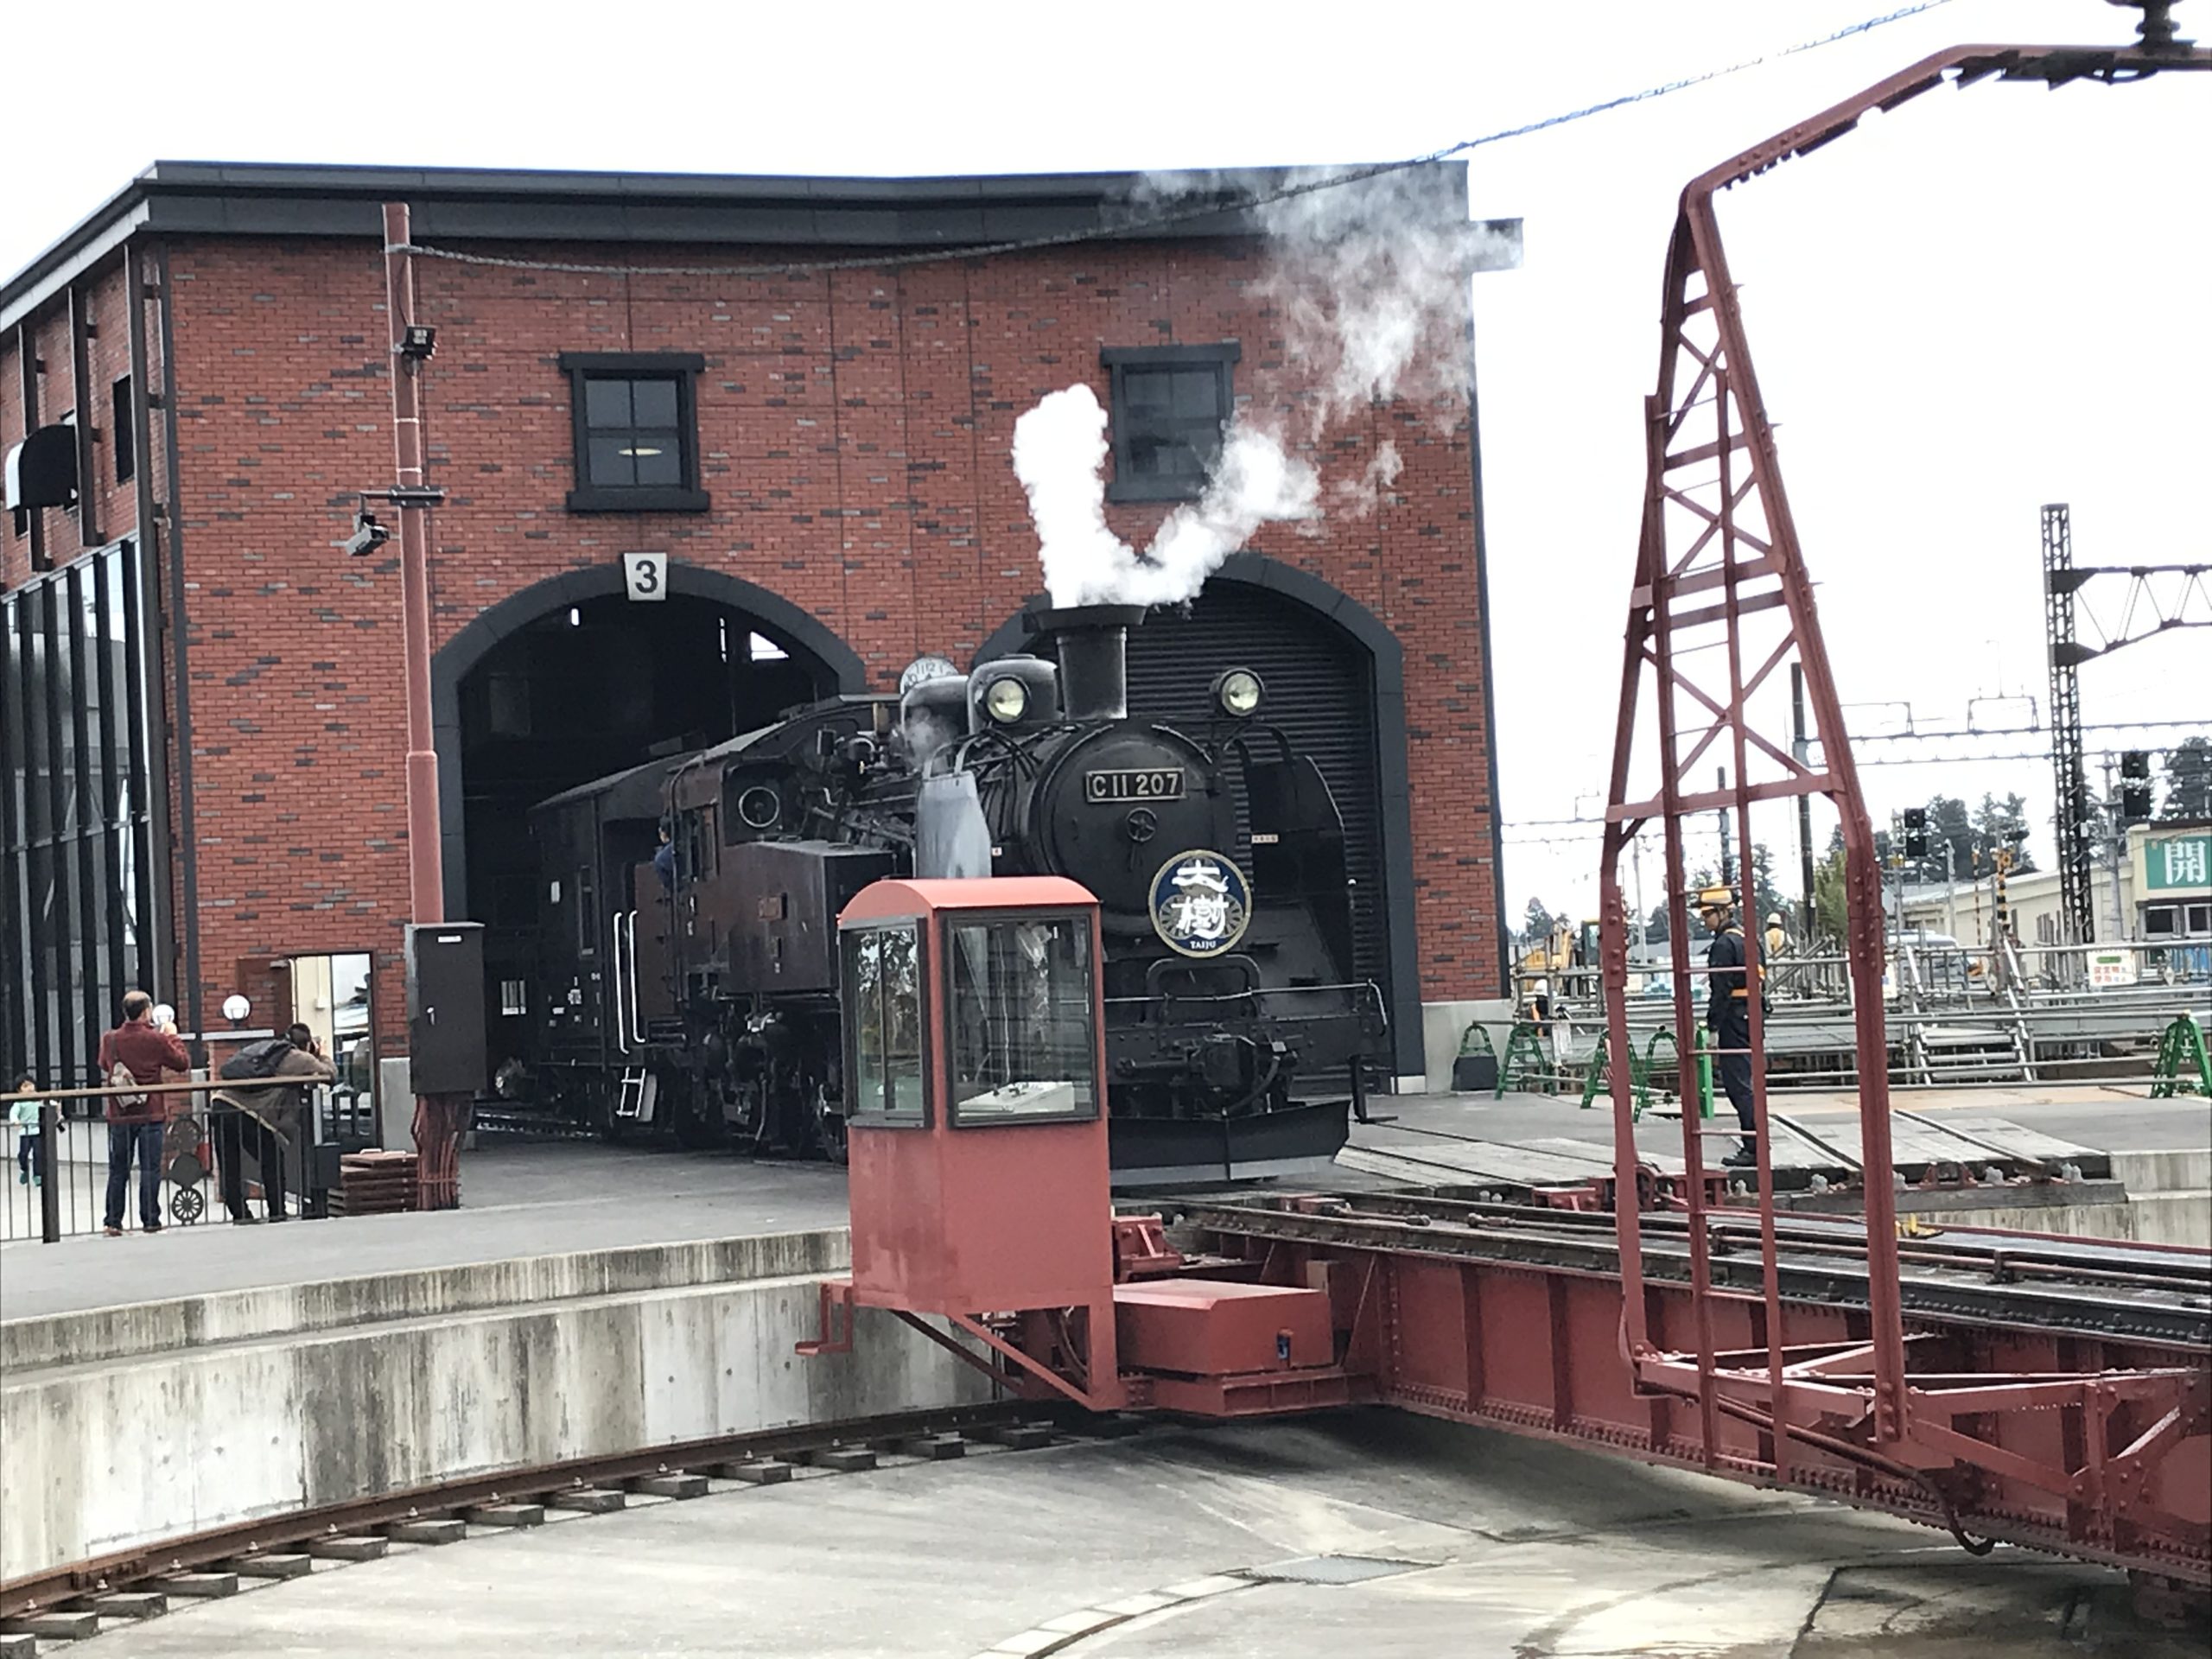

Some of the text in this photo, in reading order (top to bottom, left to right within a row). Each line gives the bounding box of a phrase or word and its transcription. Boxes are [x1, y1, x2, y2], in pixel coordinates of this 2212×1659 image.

[635, 560, 658, 594] 3
[1092, 773, 1179, 797] C11 207
[2164, 841, 2206, 885] 開
[1190, 940, 1217, 950] TAIJU
